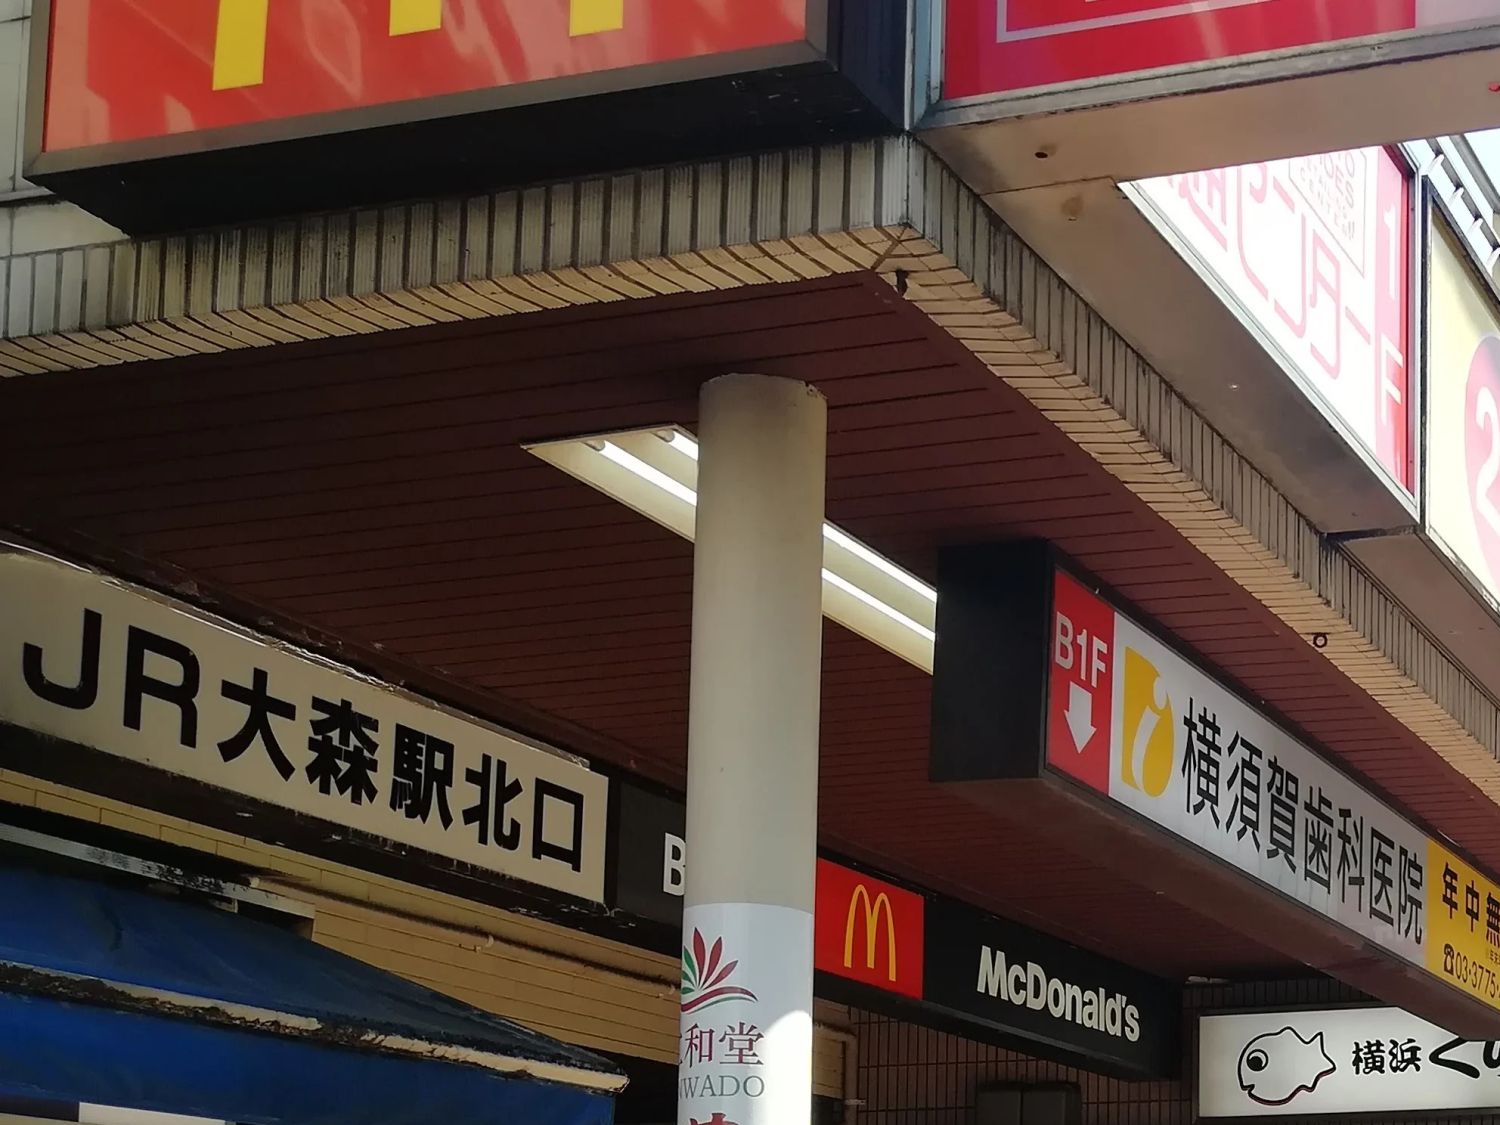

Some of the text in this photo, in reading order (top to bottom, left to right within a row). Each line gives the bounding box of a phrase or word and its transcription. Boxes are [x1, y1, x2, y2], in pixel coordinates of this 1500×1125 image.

[1054, 610, 1110, 690] B1F
[22, 608, 585, 873] JR大森駅北口
[1180, 697, 1425, 946] 横須賀歯科医院
[976, 944, 1141, 1043] McDonald's
[679, 1021, 765, 1068] 和堂
[680, 1075, 765, 1100] WADO
